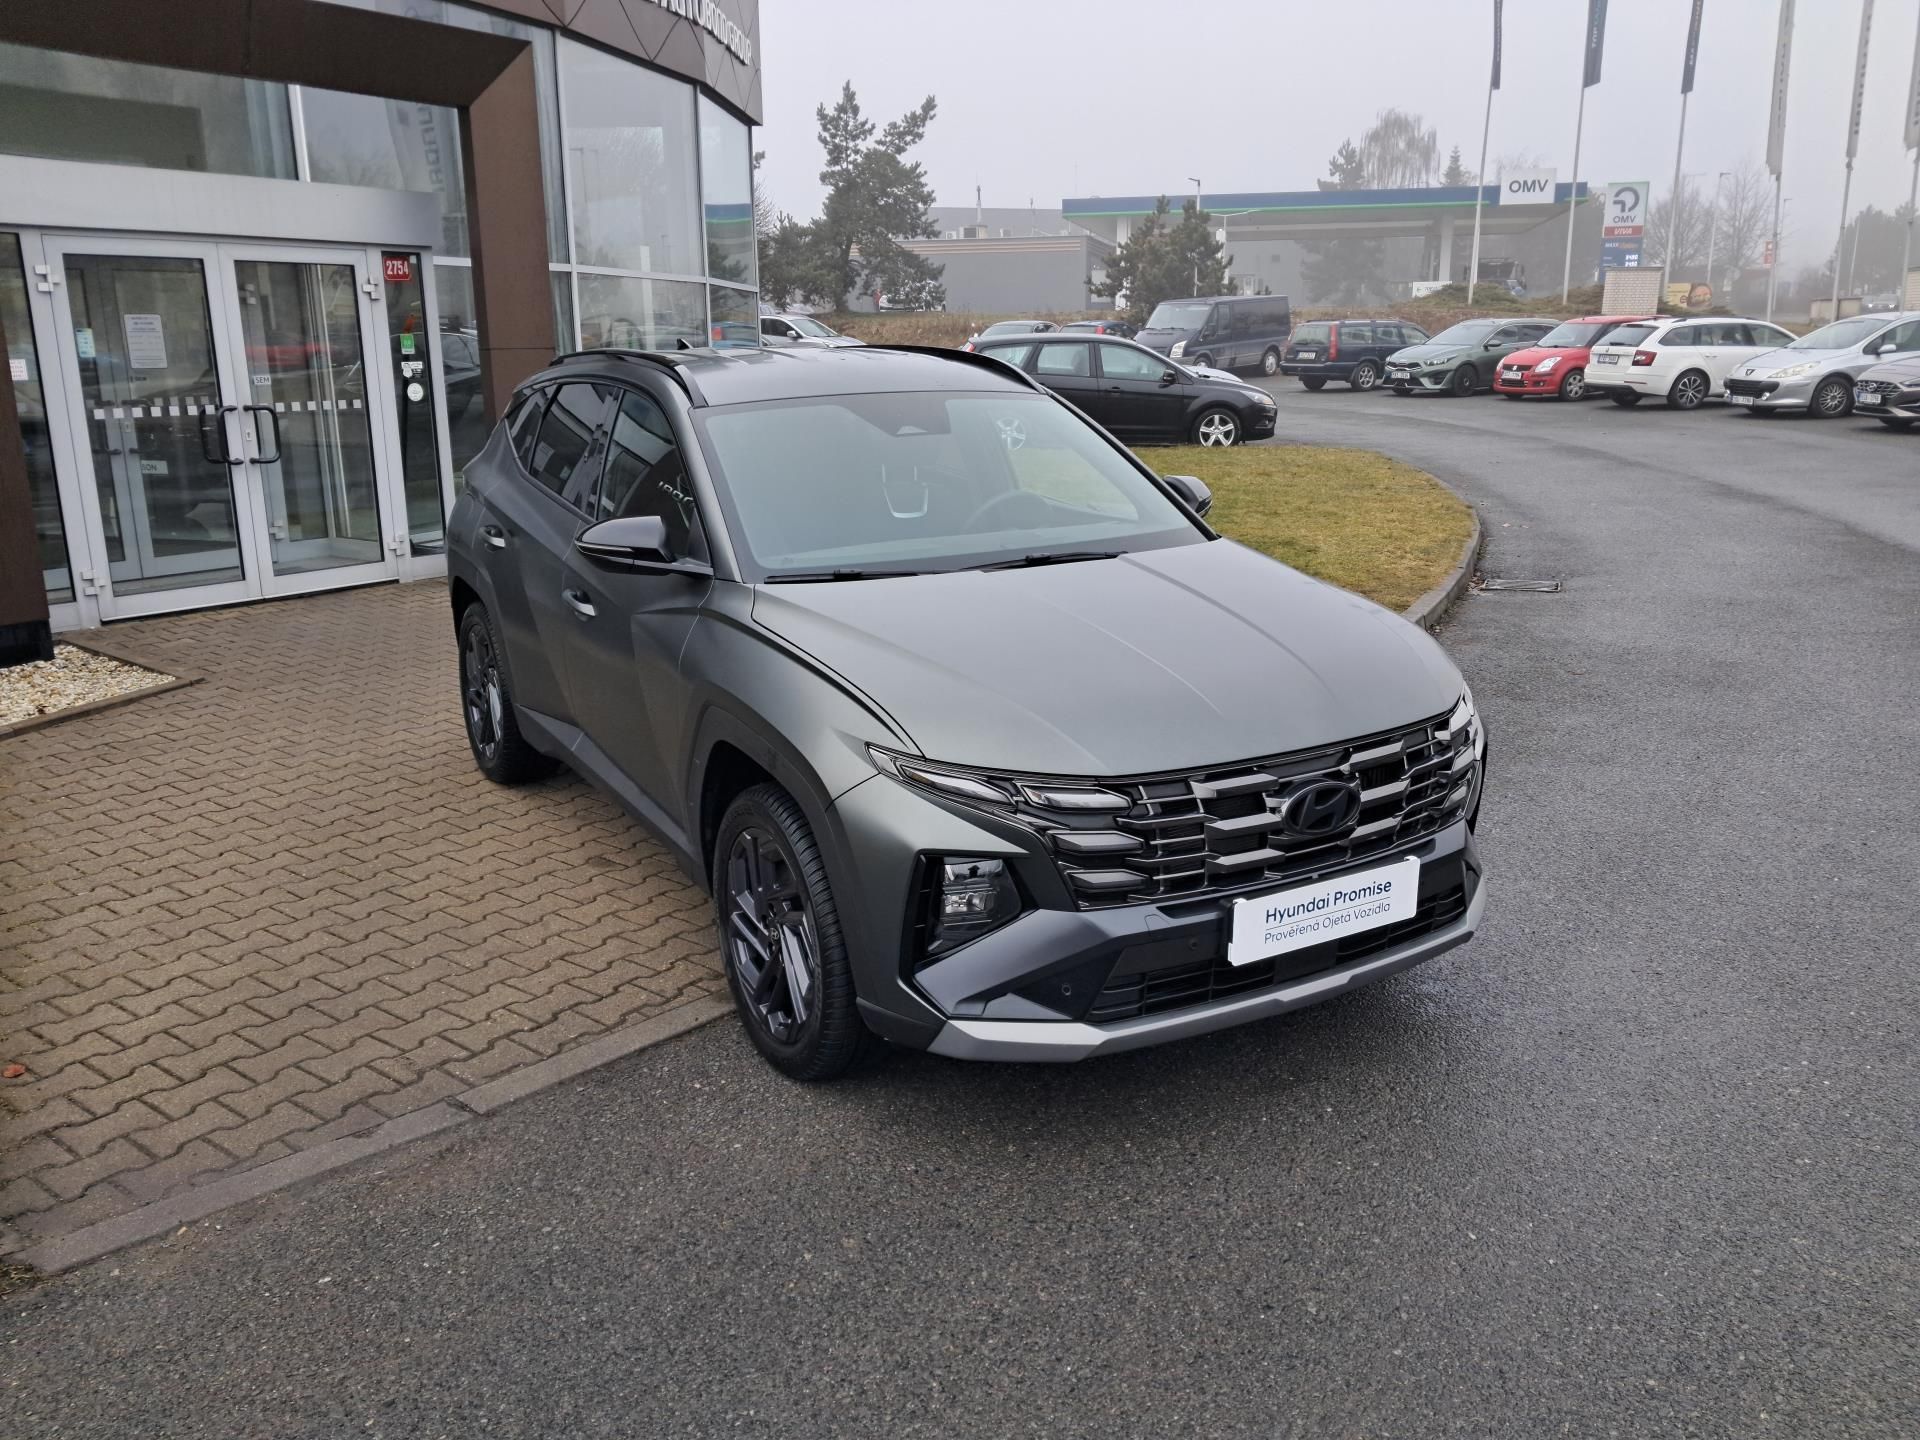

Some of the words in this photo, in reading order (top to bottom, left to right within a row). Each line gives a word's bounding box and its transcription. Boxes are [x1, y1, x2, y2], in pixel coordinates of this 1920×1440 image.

[728, 21, 752, 66] GROUP
[1508, 179, 1549, 193] OMV
[1612, 215, 1637, 224] OMV
[1614, 227, 1633, 236] VIVA
[386, 260, 409, 275] 2754
[255, 376, 270, 384] SEM
[1265, 894, 1330, 923] Hyundai
[1333, 880, 1392, 908] Promise
[1264, 919, 1320, 944] Prověřená
[1322, 911, 1351, 929] Ojetá
[1353, 901, 1391, 920] Vozidla
